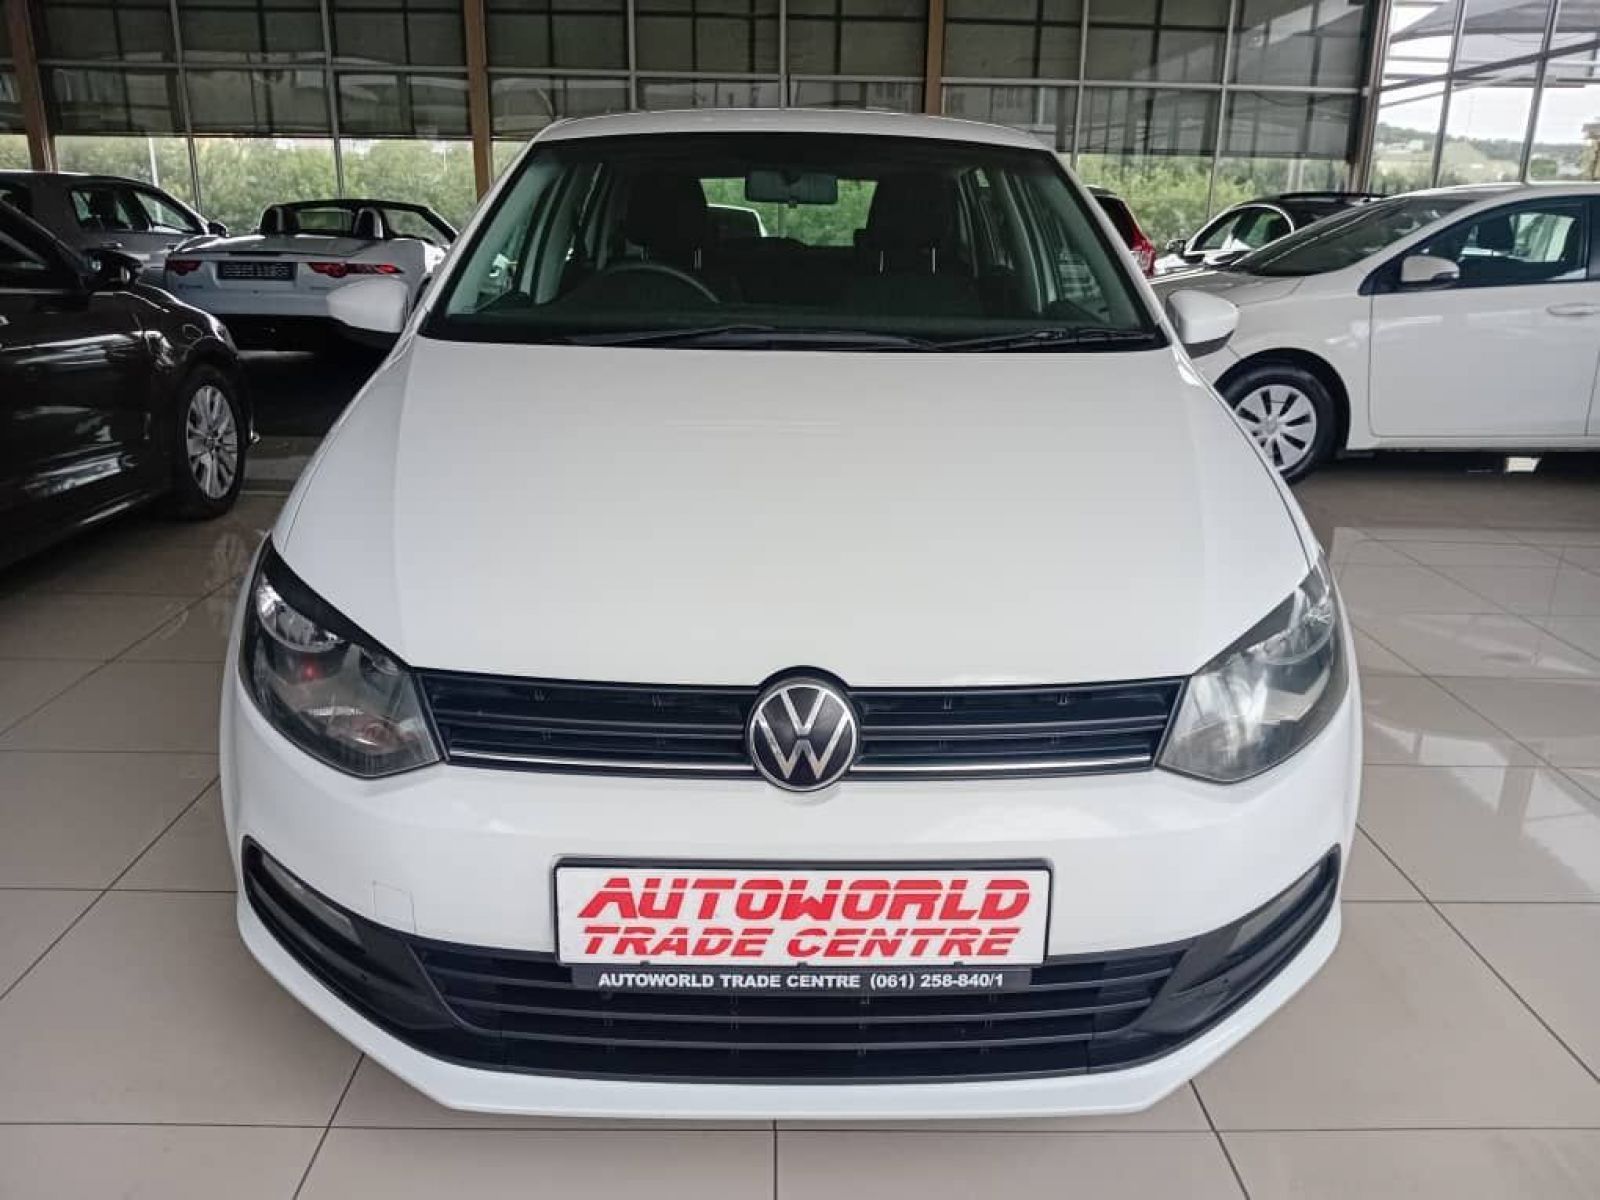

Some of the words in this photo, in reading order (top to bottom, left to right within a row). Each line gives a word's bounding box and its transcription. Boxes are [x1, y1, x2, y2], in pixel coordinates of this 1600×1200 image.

[577, 876, 1031, 921] AUTOWORLD
[584, 925, 775, 958] TRADE
[786, 926, 1021, 958] CENTRE
[599, 973, 715, 988] AUTOWORLD
[720, 974, 781, 988] TRADE
[786, 975, 861, 988] CENTRE
[870, 973, 915, 991] (061)
[920, 973, 1004, 988] 258-840/1
